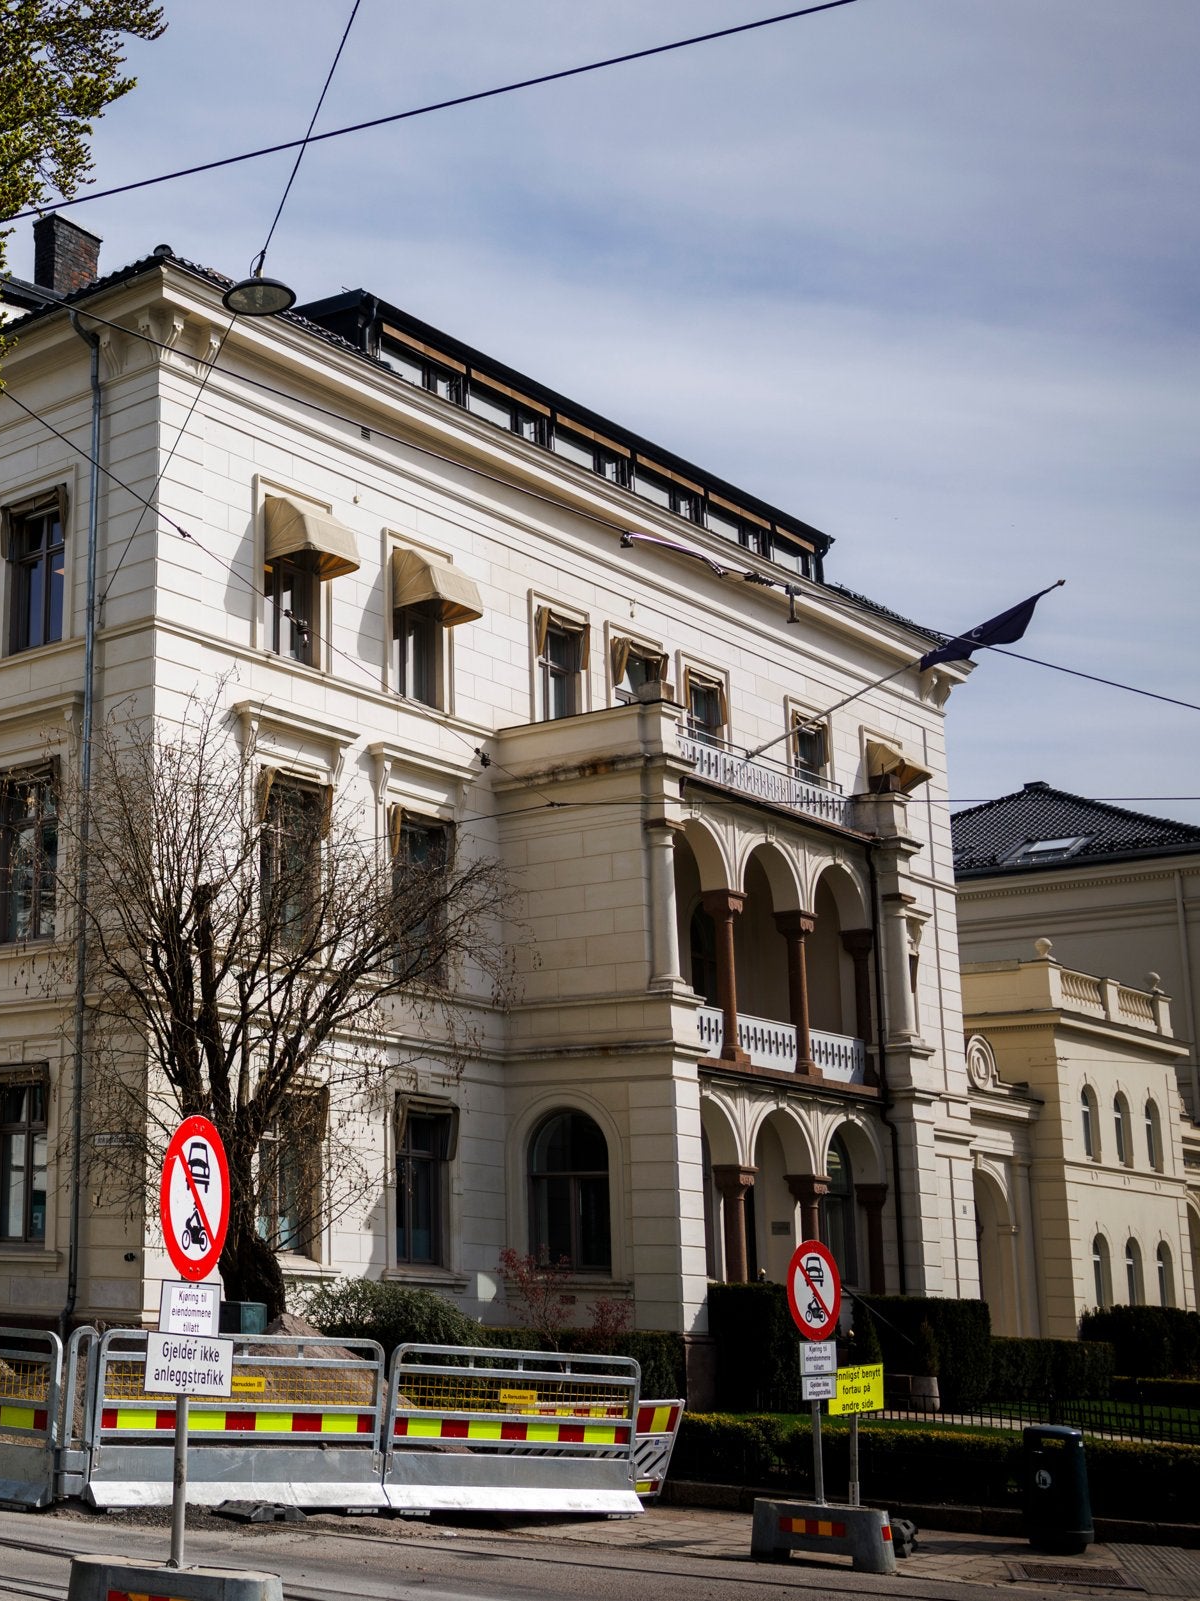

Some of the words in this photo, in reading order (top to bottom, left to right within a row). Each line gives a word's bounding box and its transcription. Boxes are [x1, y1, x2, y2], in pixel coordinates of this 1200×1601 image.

[179, 1290, 199, 1304] Kjøring
[172, 1307, 211, 1318] eiendommene
[183, 1322, 199, 1333] tillatt
[162, 1341, 197, 1362] Gjelder
[200, 1345, 219, 1363] ikke
[154, 1366, 224, 1387] anleggstrafikk
[842, 1385, 861, 1395] fortau
[863, 1383, 870, 1395] på
[842, 1401, 859, 1411] andre
[862, 1400, 873, 1409] side
